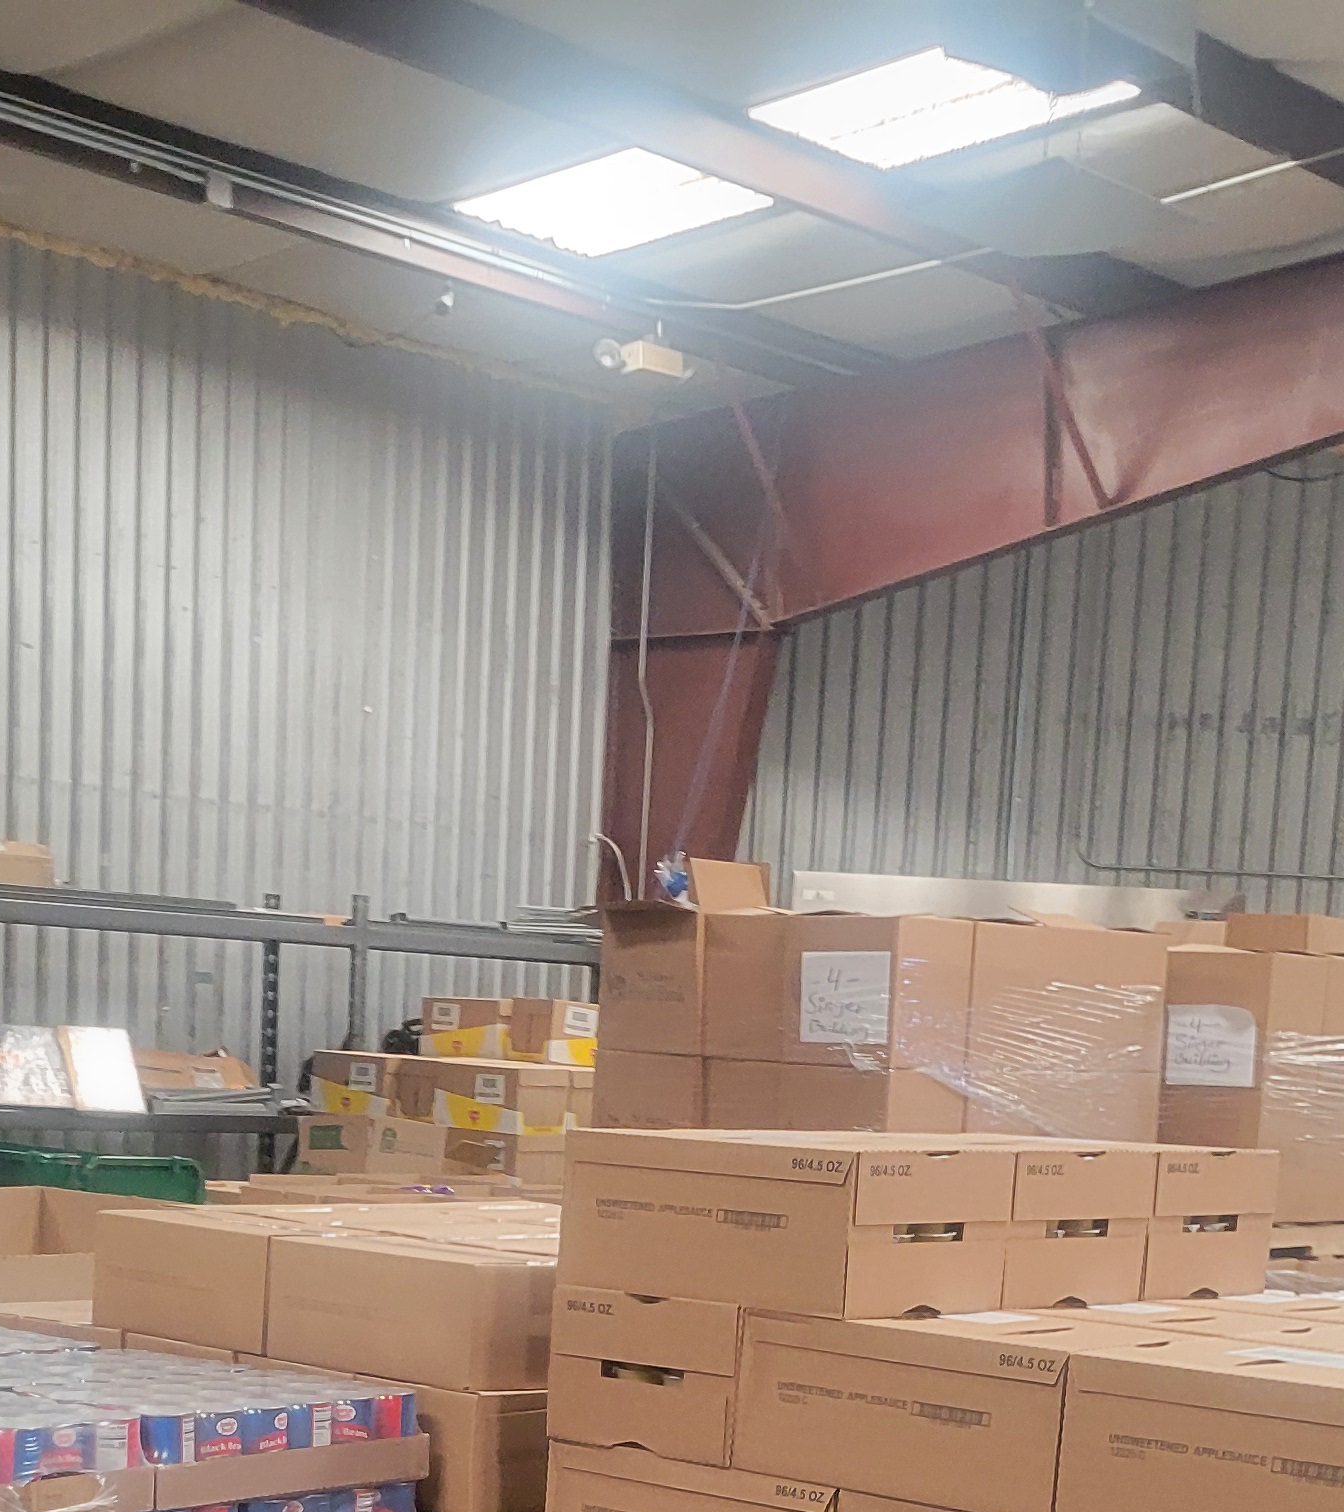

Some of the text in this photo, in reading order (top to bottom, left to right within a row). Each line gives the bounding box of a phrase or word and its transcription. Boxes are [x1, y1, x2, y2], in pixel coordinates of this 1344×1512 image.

[792, 1157, 844, 1173] 96/4.5 OZ
[898, 1164, 912, 1177] OZ
[1050, 1164, 1064, 1176] OZ
[598, 1304, 615, 1315] OZ
[999, 1353, 1056, 1373] 96/4.5 OZ
[1109, 1434, 1189, 1456] UNSWEETENED
[1193, 1447, 1269, 1467] APPLESAUCE
[775, 1484, 825, 1503] 96/4.5 OZ
